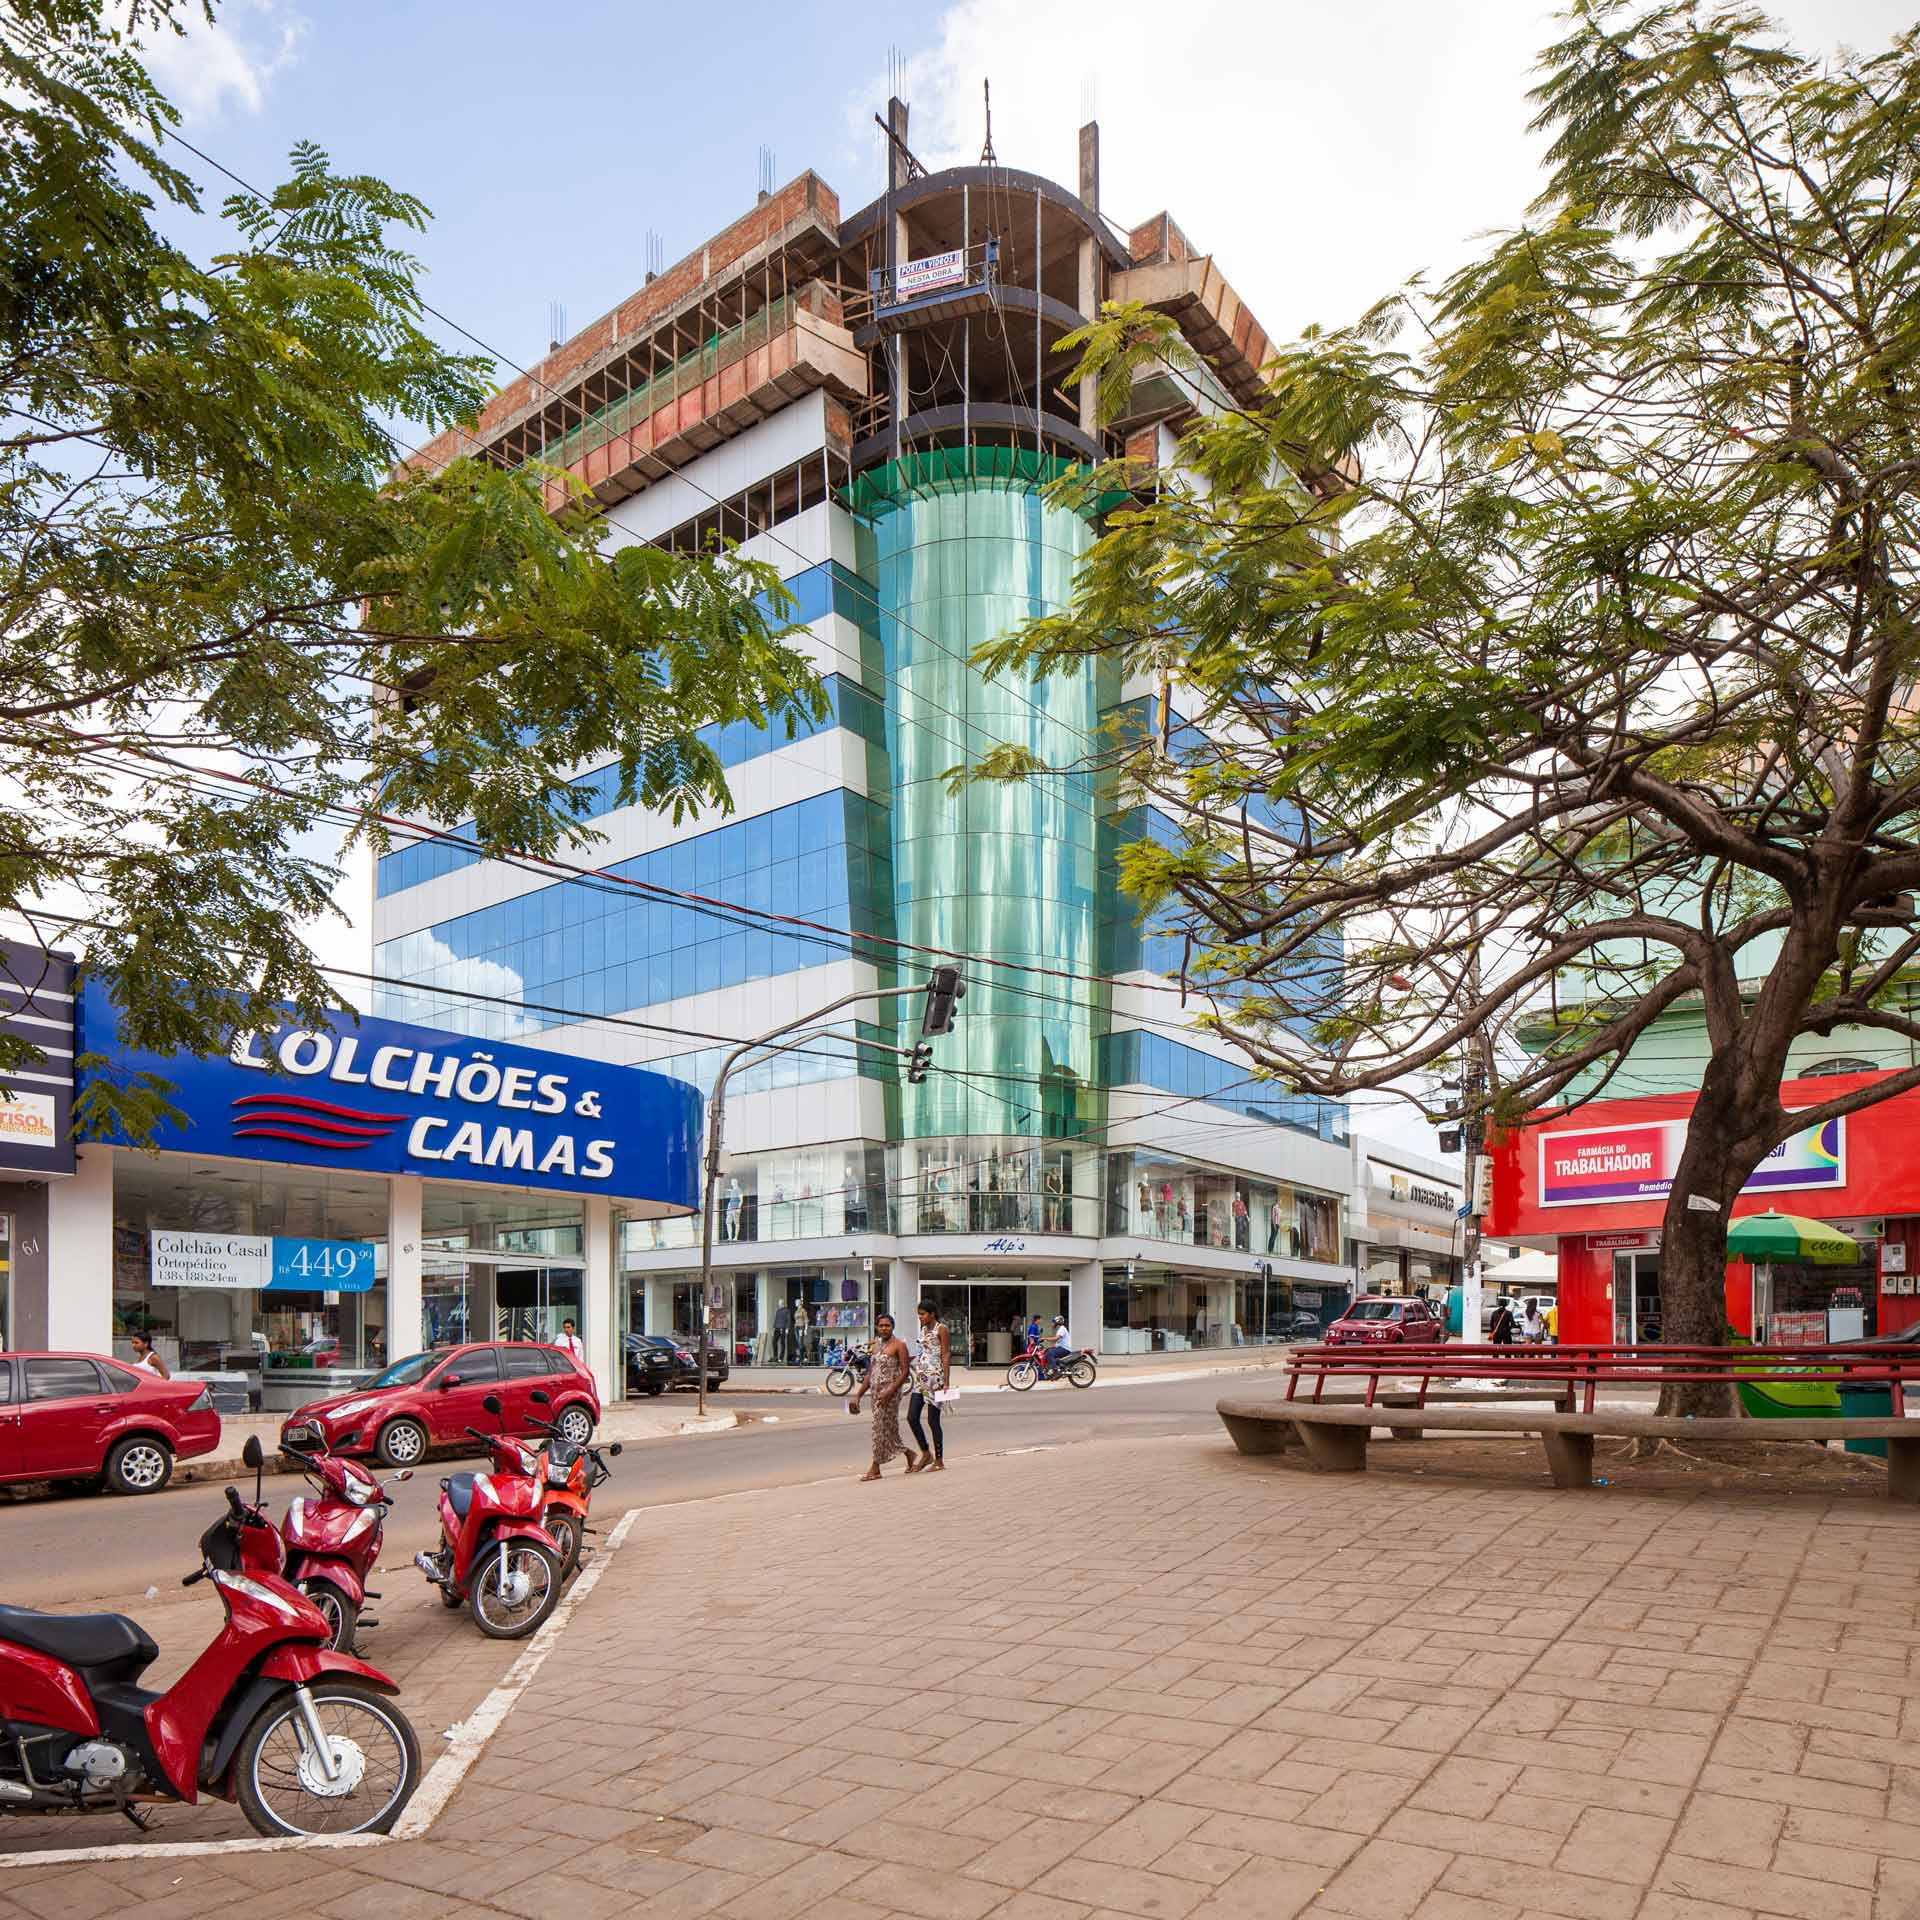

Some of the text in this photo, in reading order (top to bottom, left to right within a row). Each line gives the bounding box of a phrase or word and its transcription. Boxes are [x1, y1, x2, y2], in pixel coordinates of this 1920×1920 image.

[900, 255, 954, 275] PORTAL VIDROS
[907, 273, 931, 284] NESTA
[932, 268, 953, 278] OBRA
[230, 1023, 602, 1119] COLCHÕES &
[407, 1115, 616, 1178] CAMAS
[1577, 1144, 1627, 1157] FARMÁCIA DO
[1554, 1152, 1652, 1177] TRABALHADOR
[21, 1239, 40, 1256] 61
[157, 1237, 267, 1258] Colchão Casal
[984, 1238, 1025, 1253] Alp's
[157, 1255, 228, 1270] Ortopédico
